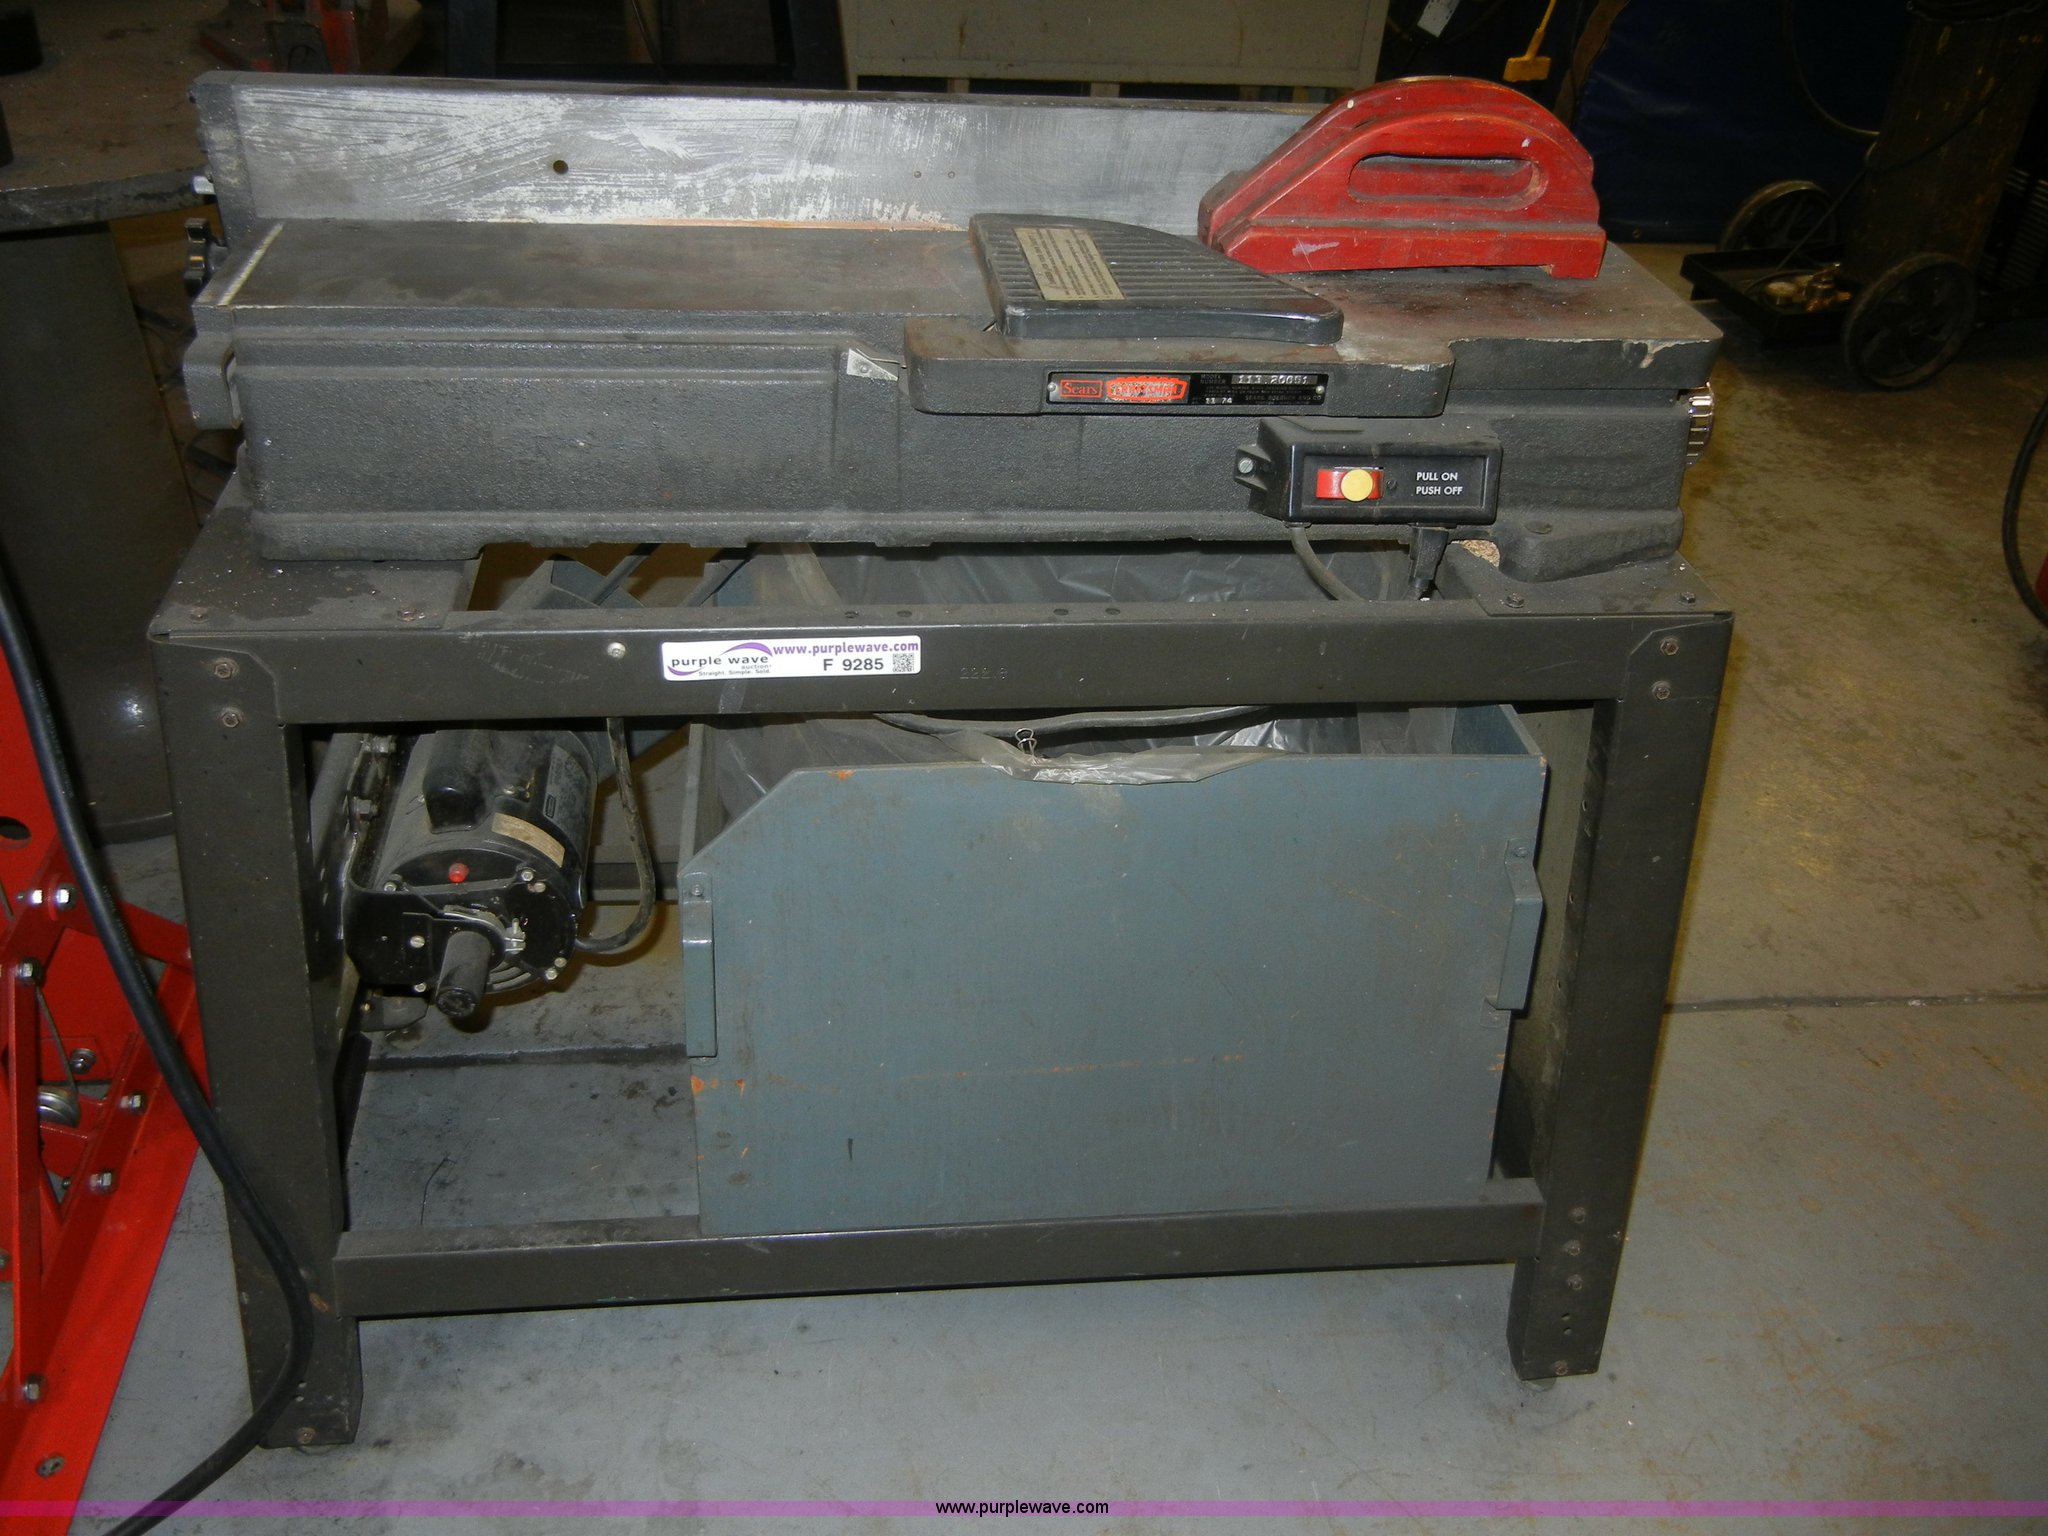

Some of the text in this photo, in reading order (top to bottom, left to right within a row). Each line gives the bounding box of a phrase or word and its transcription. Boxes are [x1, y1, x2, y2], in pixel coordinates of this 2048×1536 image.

[1062, 382, 1098, 395] Sears
[1416, 471, 1458, 481] PULL ON
[1416, 486, 1463, 495] PUSH OFF
[773, 641, 919, 657] www.purplewave.com
[671, 656, 769, 668] purple wave
[823, 658, 884, 671] F 9285
